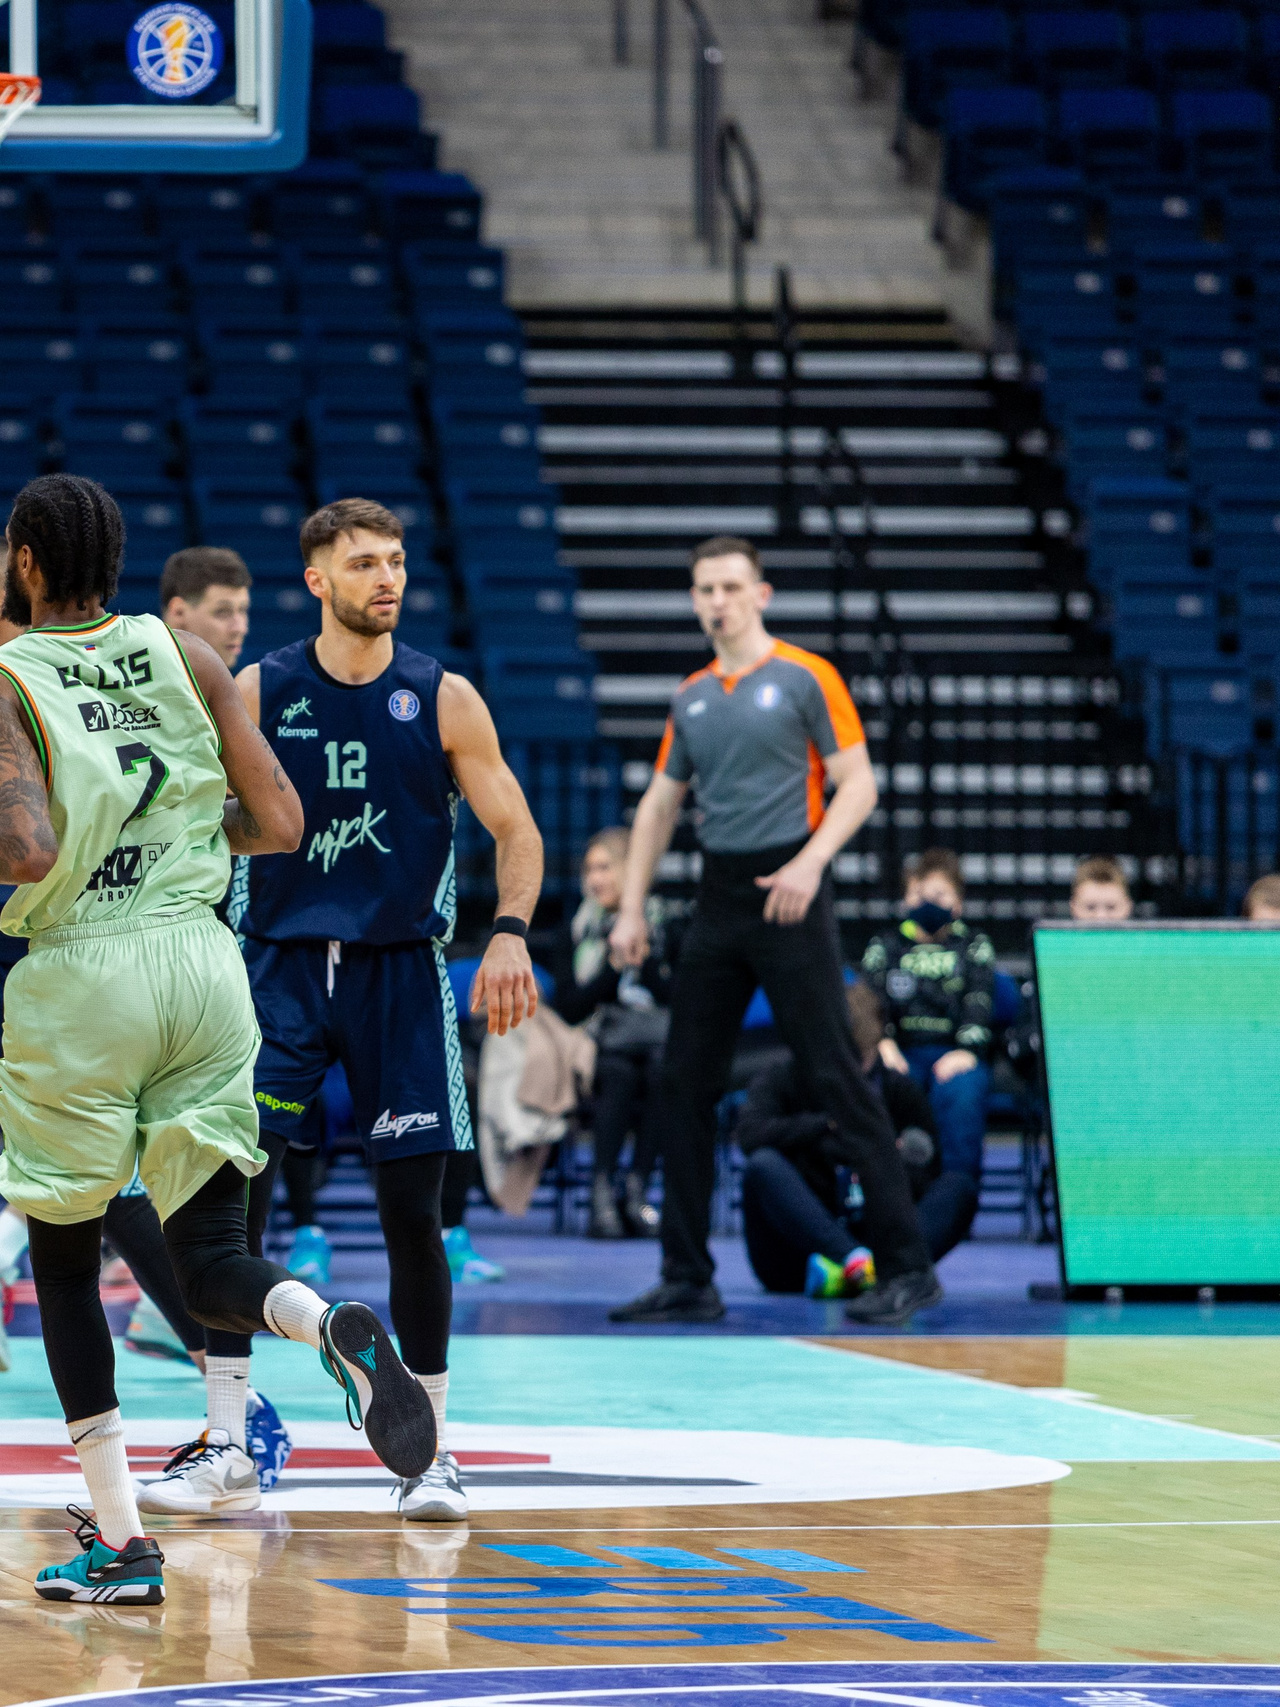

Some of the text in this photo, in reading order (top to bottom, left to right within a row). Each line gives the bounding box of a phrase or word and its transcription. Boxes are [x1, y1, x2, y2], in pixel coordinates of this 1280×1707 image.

[56, 648, 154, 691] ELLIS
[277, 725, 319, 740] Kempa
[324, 741, 367, 789] 12
